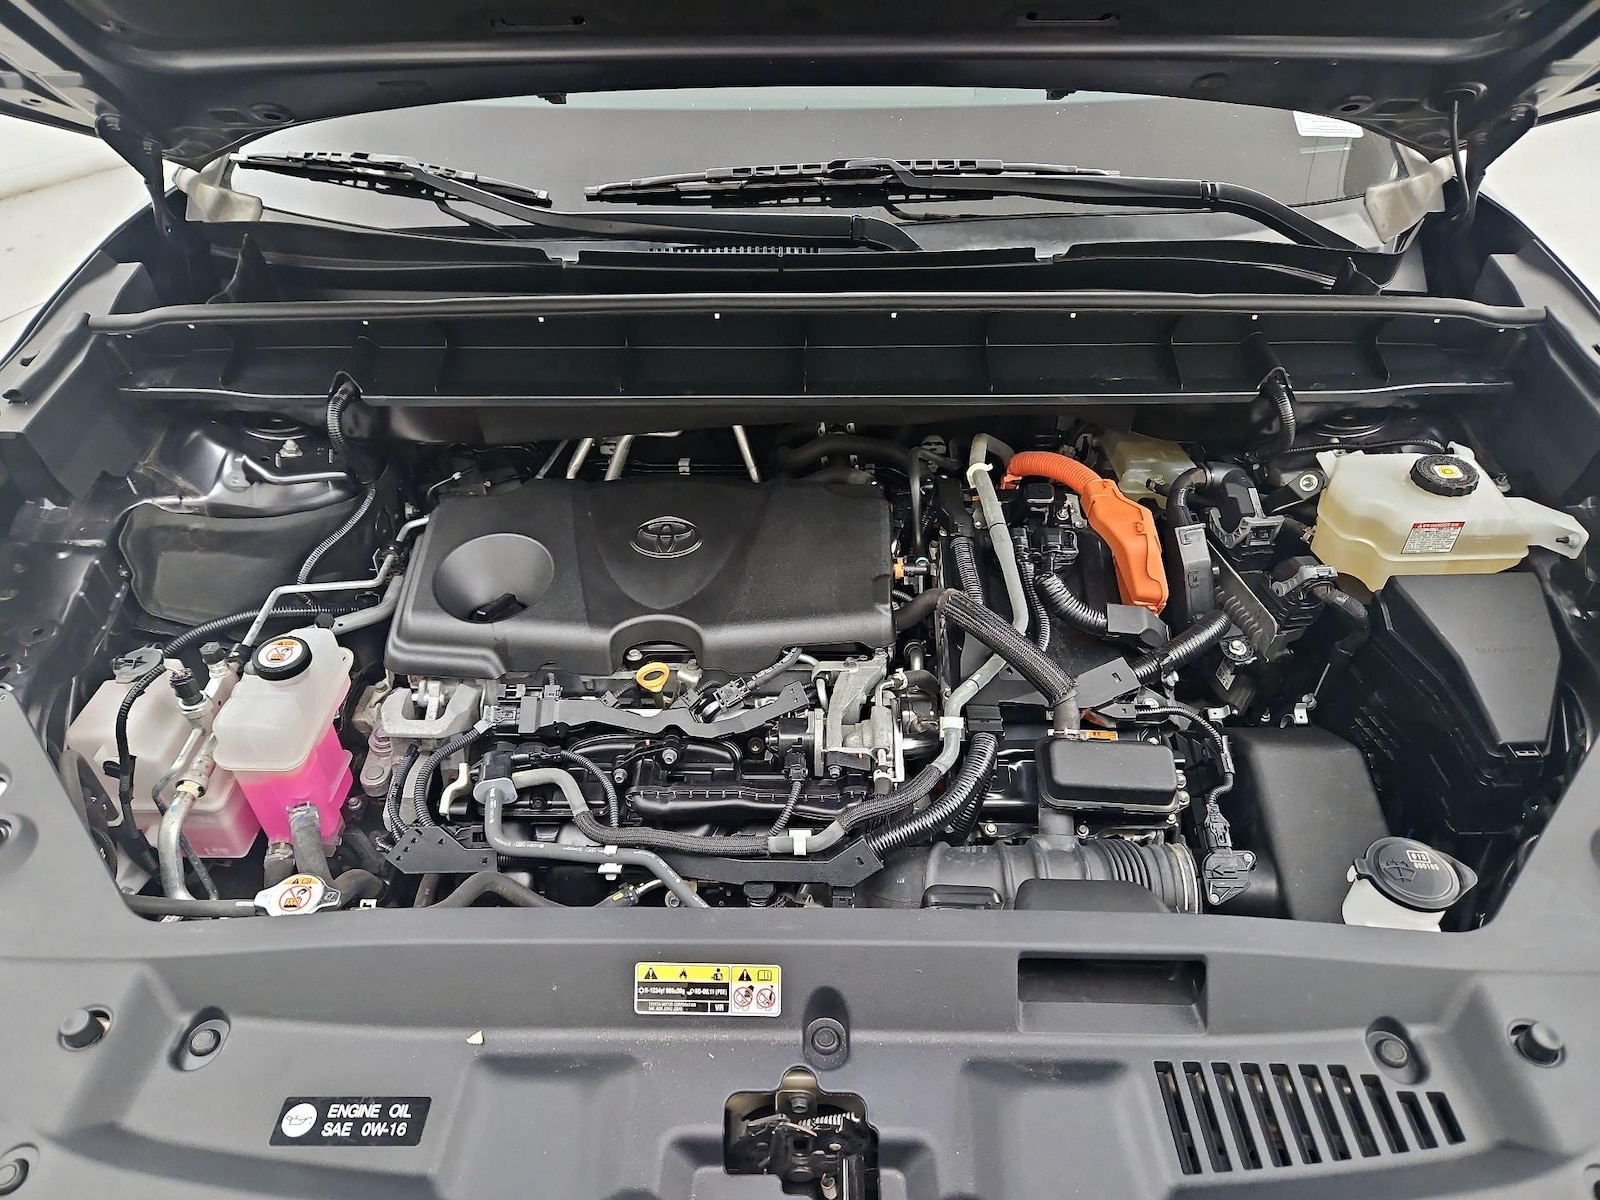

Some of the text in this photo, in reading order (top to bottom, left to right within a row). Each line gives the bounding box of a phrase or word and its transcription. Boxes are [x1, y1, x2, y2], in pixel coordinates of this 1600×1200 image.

[327, 1103, 412, 1119] ENGINE OIL
[321, 1122, 407, 1137] SAE 0W-16
